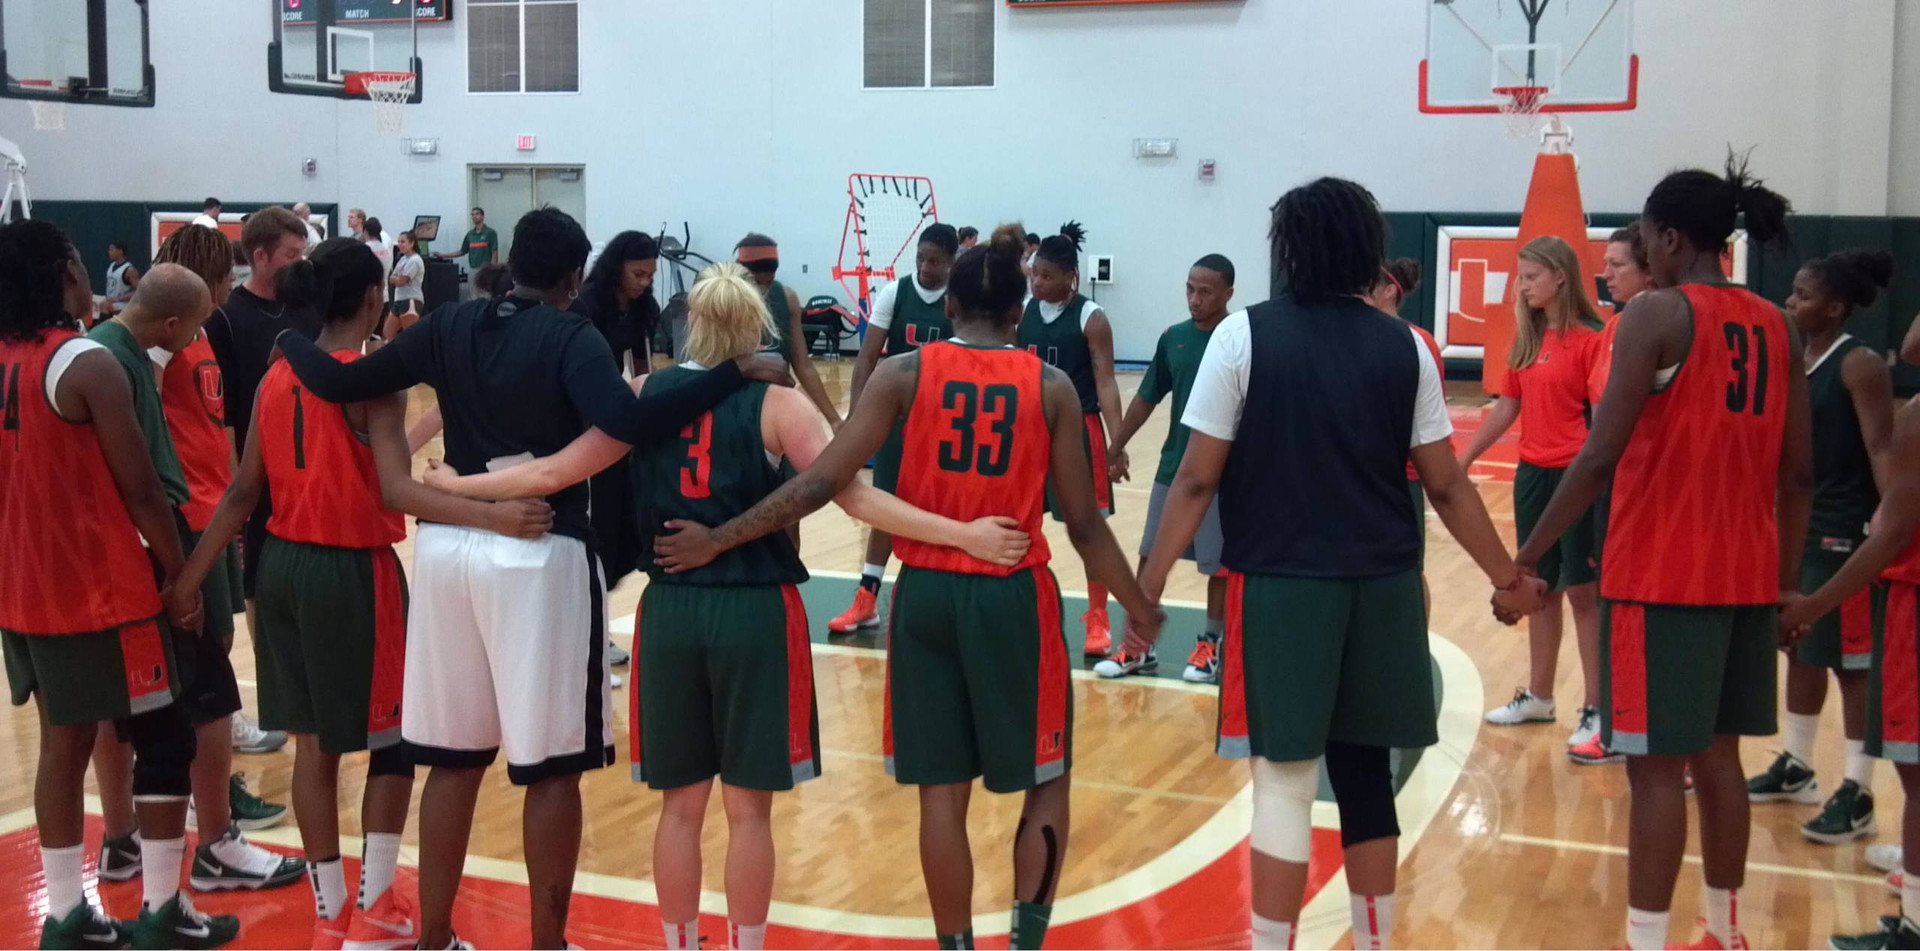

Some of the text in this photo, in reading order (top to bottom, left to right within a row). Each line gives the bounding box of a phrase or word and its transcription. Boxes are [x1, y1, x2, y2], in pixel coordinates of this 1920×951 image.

[345, 9, 370, 19] MATCH
[906, 324, 940, 346] U
[1723, 321, 1768, 415] 31
[0, 362, 21, 452] 4
[204, 370, 223, 400] U
[292, 385, 305, 469] 1
[938, 380, 1018, 476] 33
[680, 409, 713, 499] 3
